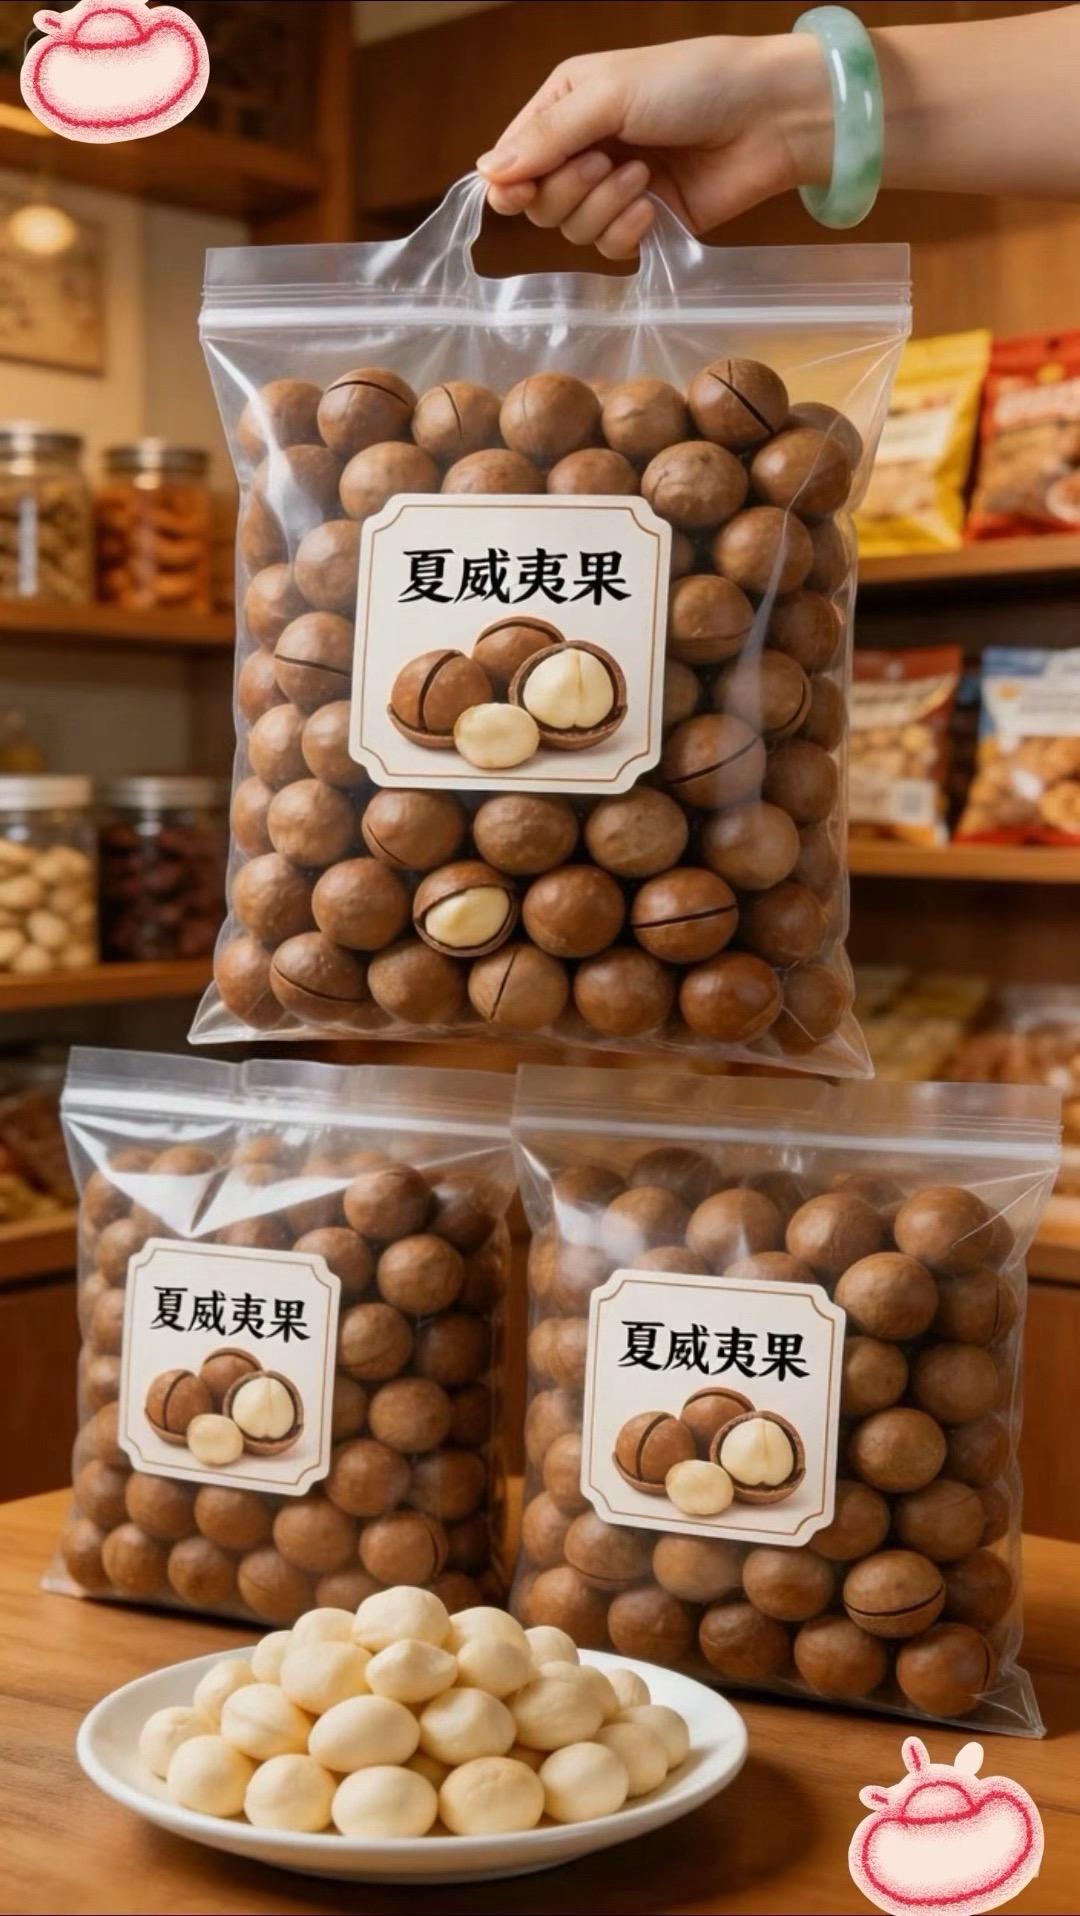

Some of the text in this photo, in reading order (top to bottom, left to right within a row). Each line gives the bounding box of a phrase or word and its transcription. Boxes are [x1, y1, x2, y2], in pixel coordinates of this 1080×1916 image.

[398, 547, 632, 605] 夏威夷果
[151, 1286, 311, 1343] 夏威夷果
[618, 1320, 810, 1382] 夏威夷果
